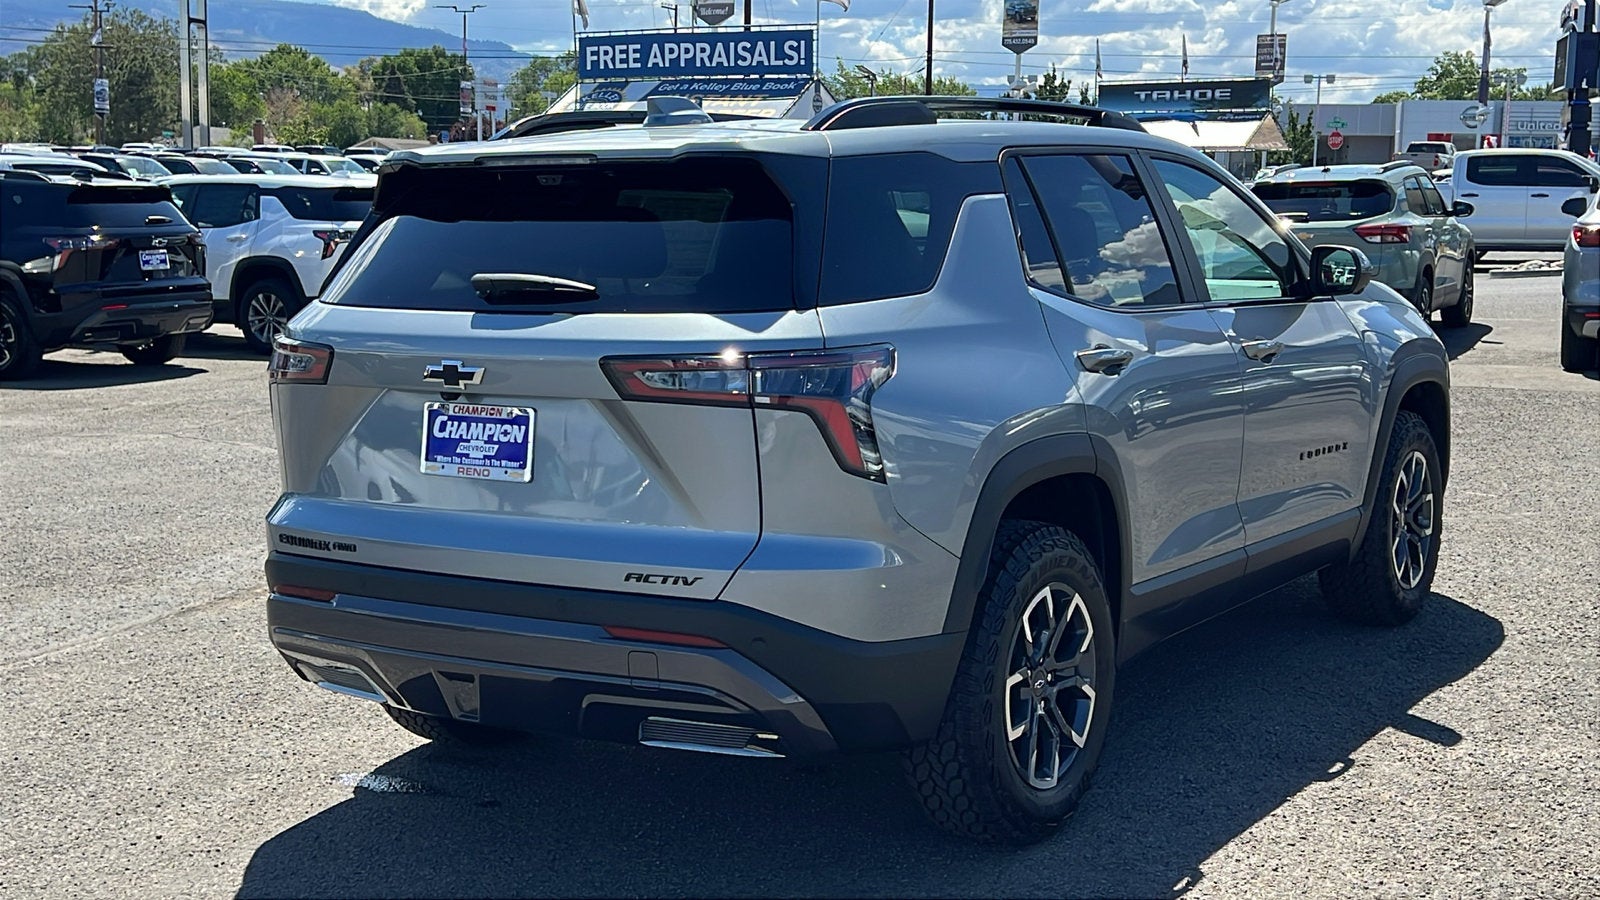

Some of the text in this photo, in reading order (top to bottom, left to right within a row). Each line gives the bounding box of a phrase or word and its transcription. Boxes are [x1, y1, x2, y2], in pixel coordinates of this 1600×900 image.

[586, 40, 807, 70] FREE APPRAISALS!
[658, 83, 678, 91] Get
[690, 82, 730, 92] Kelley
[730, 83, 760, 91] Blue
[1134, 88, 1232, 102] TAHOE
[1329, 136, 1343, 144] STOP
[452, 405, 504, 416] CHAMPION
[433, 415, 526, 443] CHAMPION
[459, 444, 496, 453] CHEVROLET
[461, 457, 485, 465] Customer
[491, 459, 501, 467] The
[457, 466, 491, 477] RENO
[278, 533, 332, 552] EQUINOX
[623, 572, 704, 587] ACTIV
